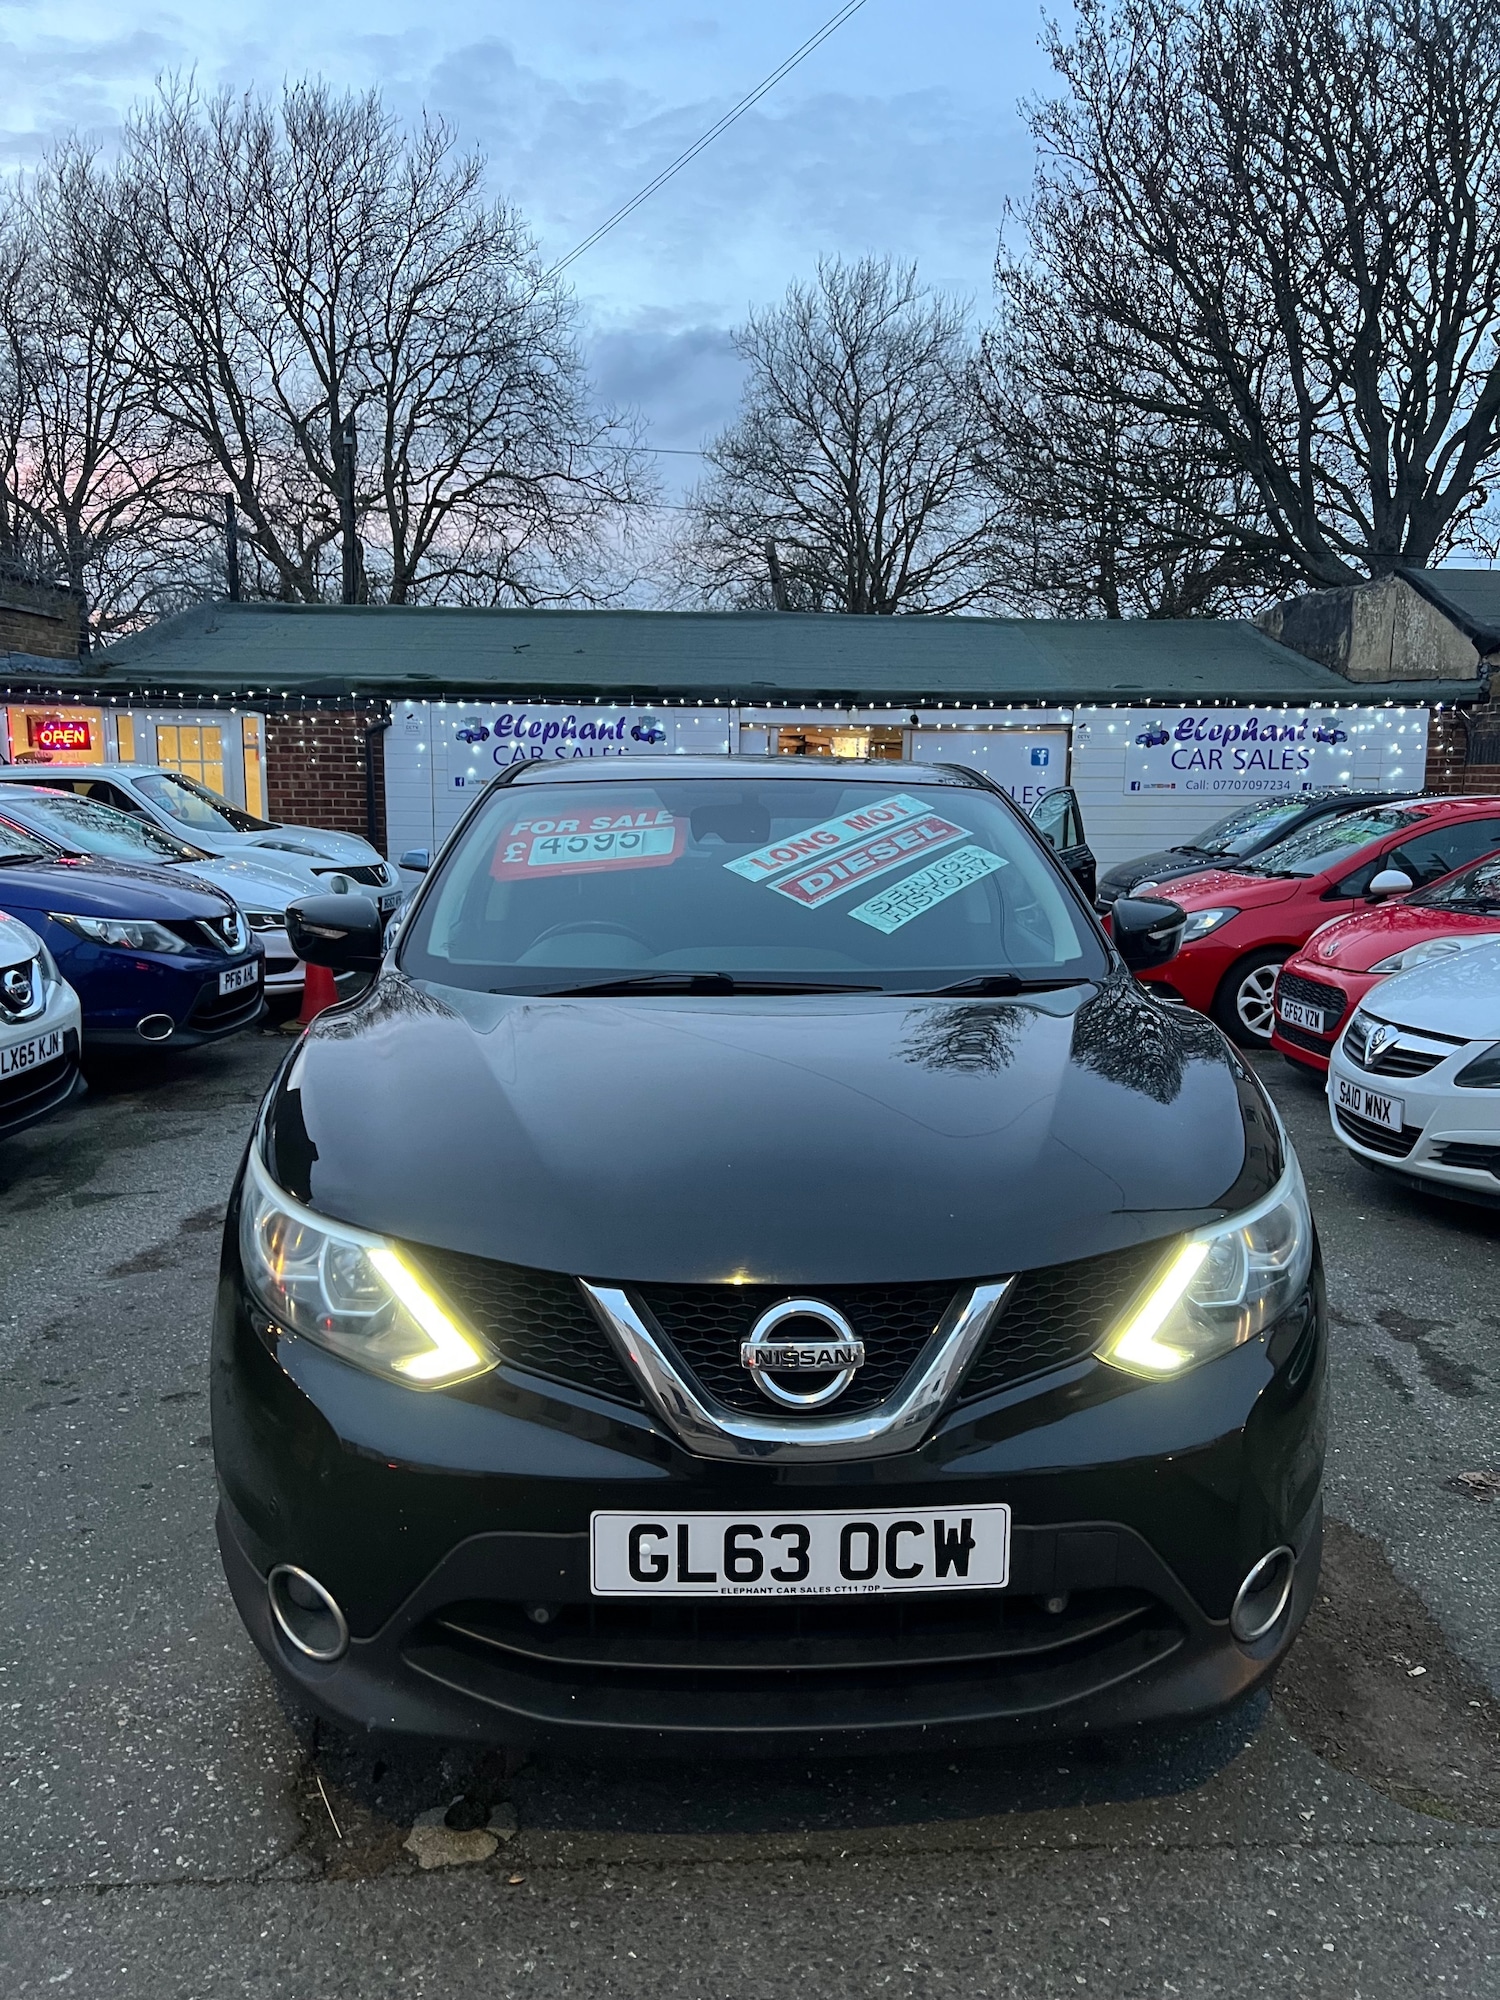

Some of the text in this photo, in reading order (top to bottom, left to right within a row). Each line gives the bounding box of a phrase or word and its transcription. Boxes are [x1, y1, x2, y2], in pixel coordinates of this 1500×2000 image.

[40, 729, 86, 744] OPEN
[493, 713, 626, 745] Elephant
[1173, 717, 1309, 747] Elephant
[493, 745, 545, 766] CAR
[1171, 748, 1311, 771] CAR SALES
[1185, 780, 1209, 791] Call:
[1212, 780, 1291, 791] 07707097234
[510, 809, 676, 837] FOR SALE
[750, 801, 911, 872] LONG MOT
[502, 830, 642, 864] £ 4595
[796, 822, 949, 897] DIESEL
[863, 851, 976, 917] SERVICE
[878, 857, 993, 924] HISTORY
[1, 1031, 59, 1075] LX65 KJN
[1339, 1081, 1392, 1124] SA10 WNX
[755, 1349, 856, 1366] NISSAN
[628, 1518, 975, 1583] GL63 OCW
[721, 1587, 773, 1595] ELEPHANT
